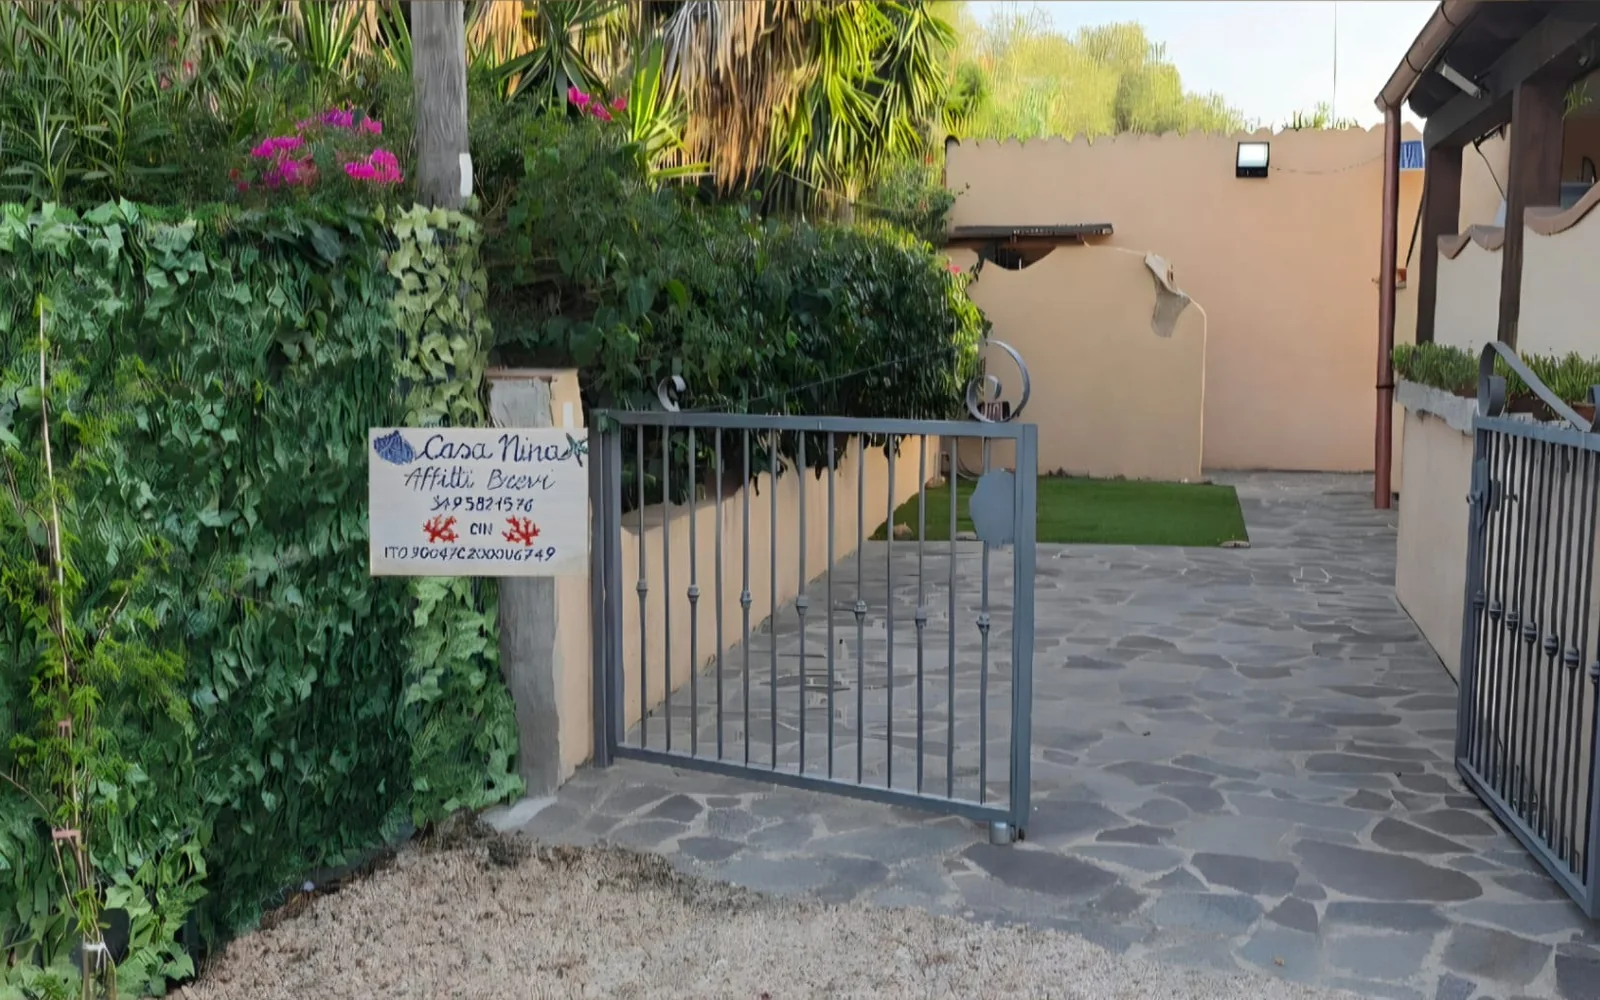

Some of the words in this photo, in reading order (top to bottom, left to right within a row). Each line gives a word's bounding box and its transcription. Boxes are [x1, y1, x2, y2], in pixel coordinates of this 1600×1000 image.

[414, 433, 493, 461] Casa
[498, 433, 567, 462] Nina
[404, 465, 474, 491] Affitti
[487, 468, 556, 491] Brevi
[470, 522, 493, 535] CIN
